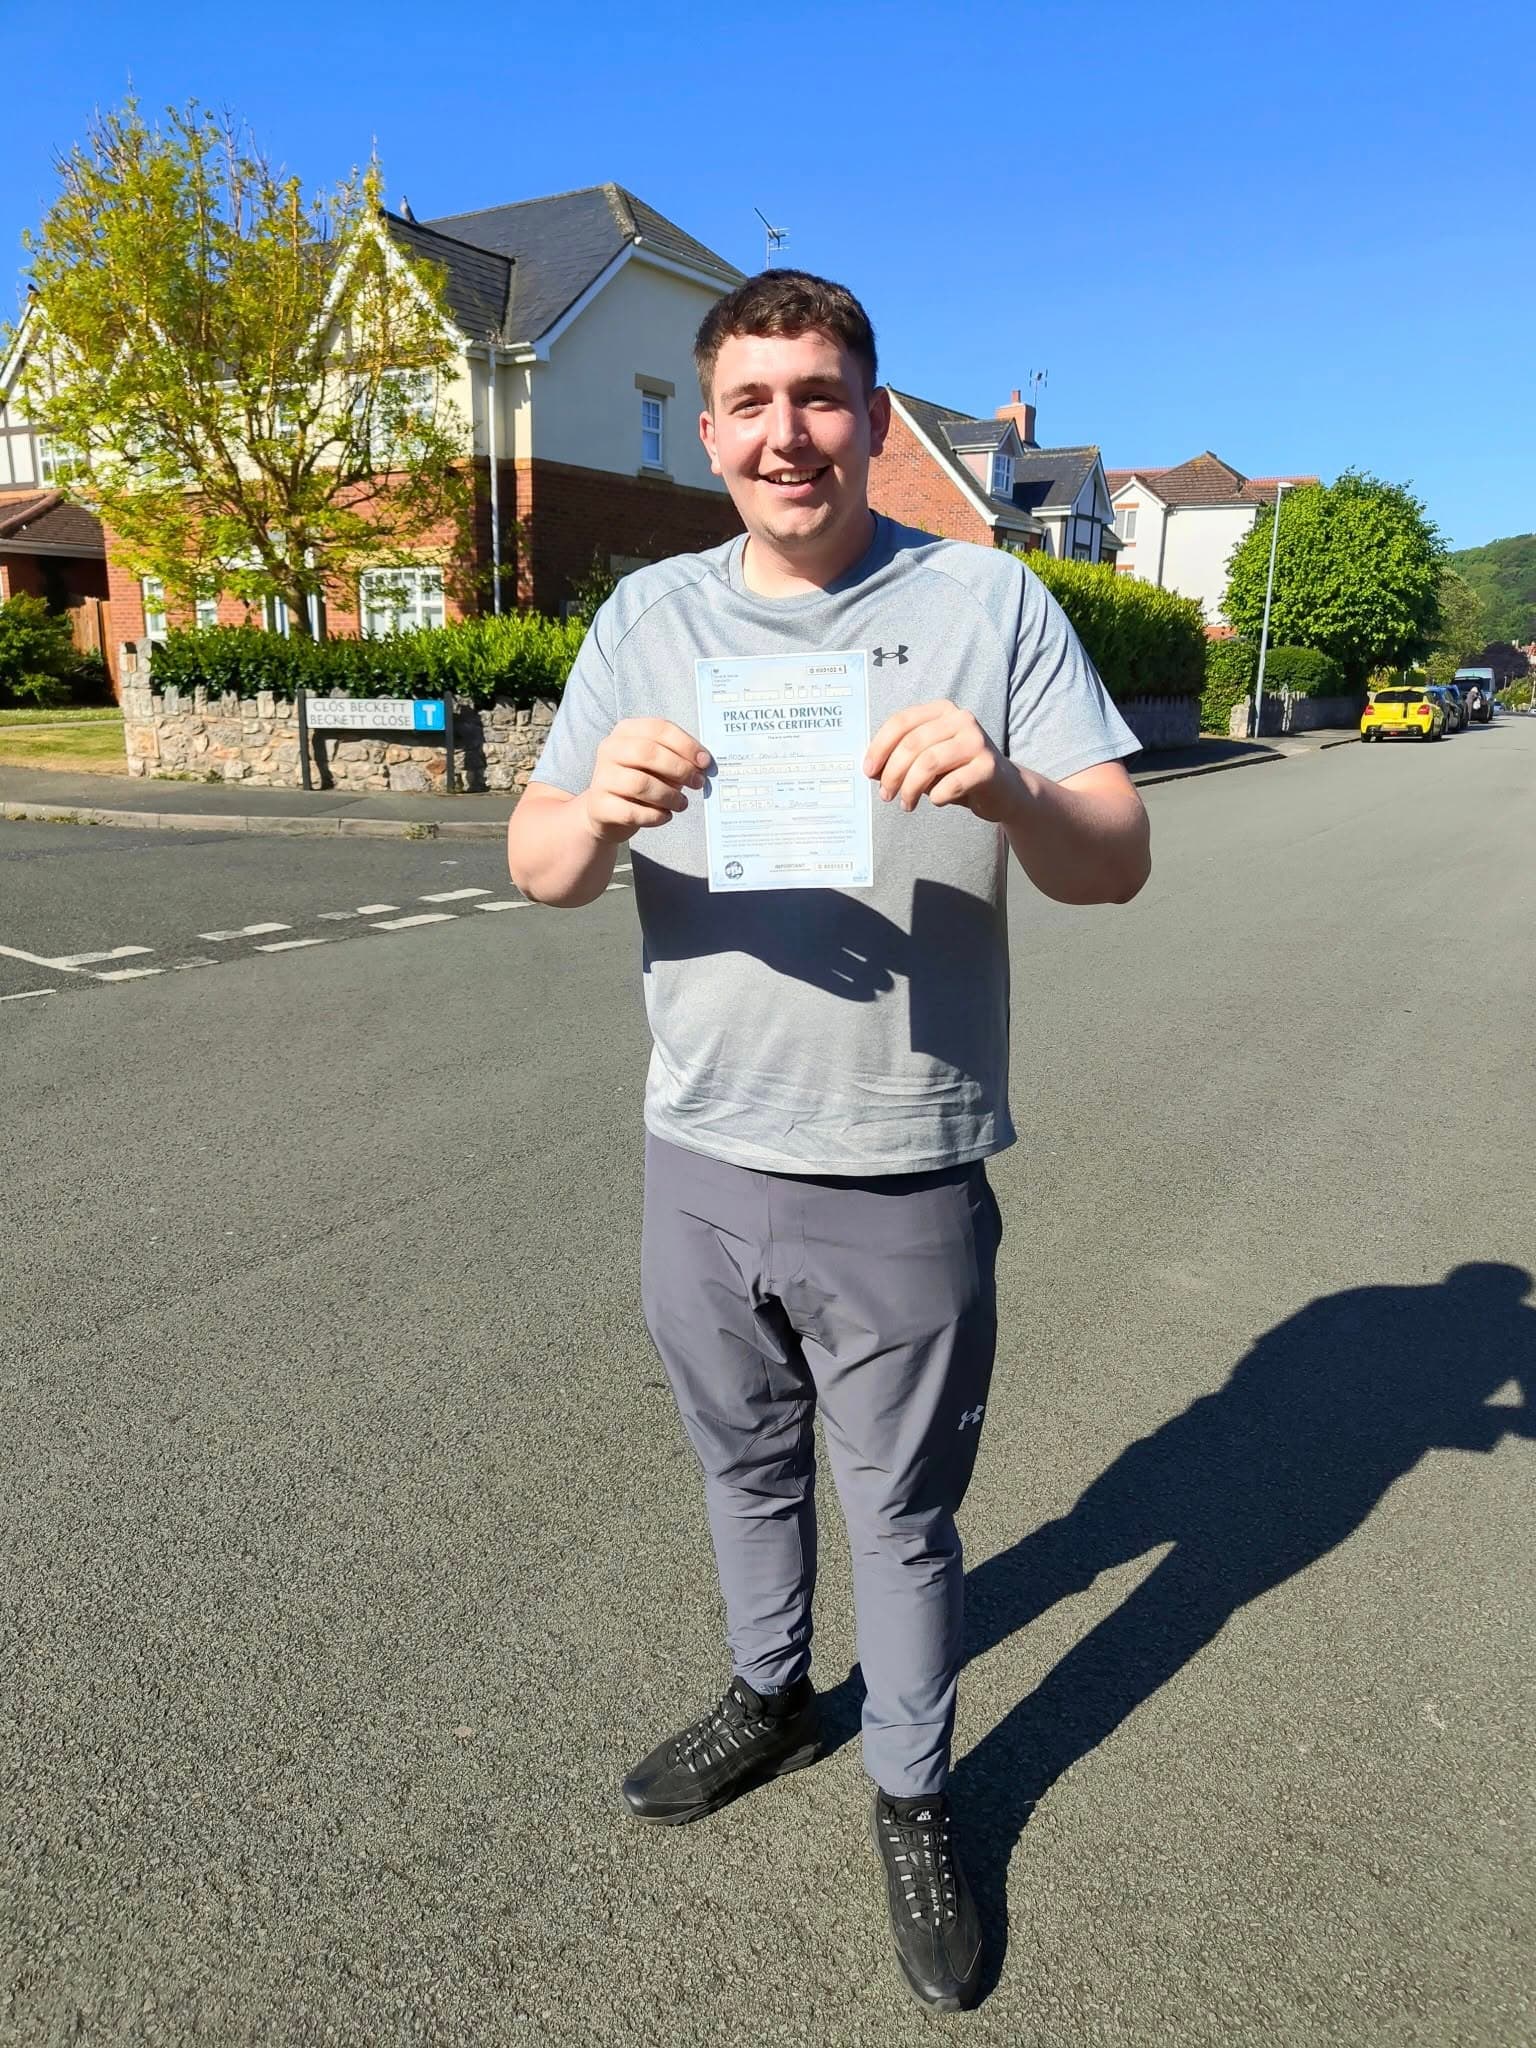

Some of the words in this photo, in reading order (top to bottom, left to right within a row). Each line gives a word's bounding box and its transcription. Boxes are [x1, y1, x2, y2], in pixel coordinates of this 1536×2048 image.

[351, 702, 405, 712] BECKETT
[723, 709, 787, 721] PRACTICAL
[789, 705, 843, 718] DRIVING
[310, 715, 365, 725] BECKETT
[373, 715, 411, 726] CLOSE
[724, 722, 749, 733] TEST
[751, 720, 776, 731] PASS
[778, 717, 843, 730] CERTIFICATE
